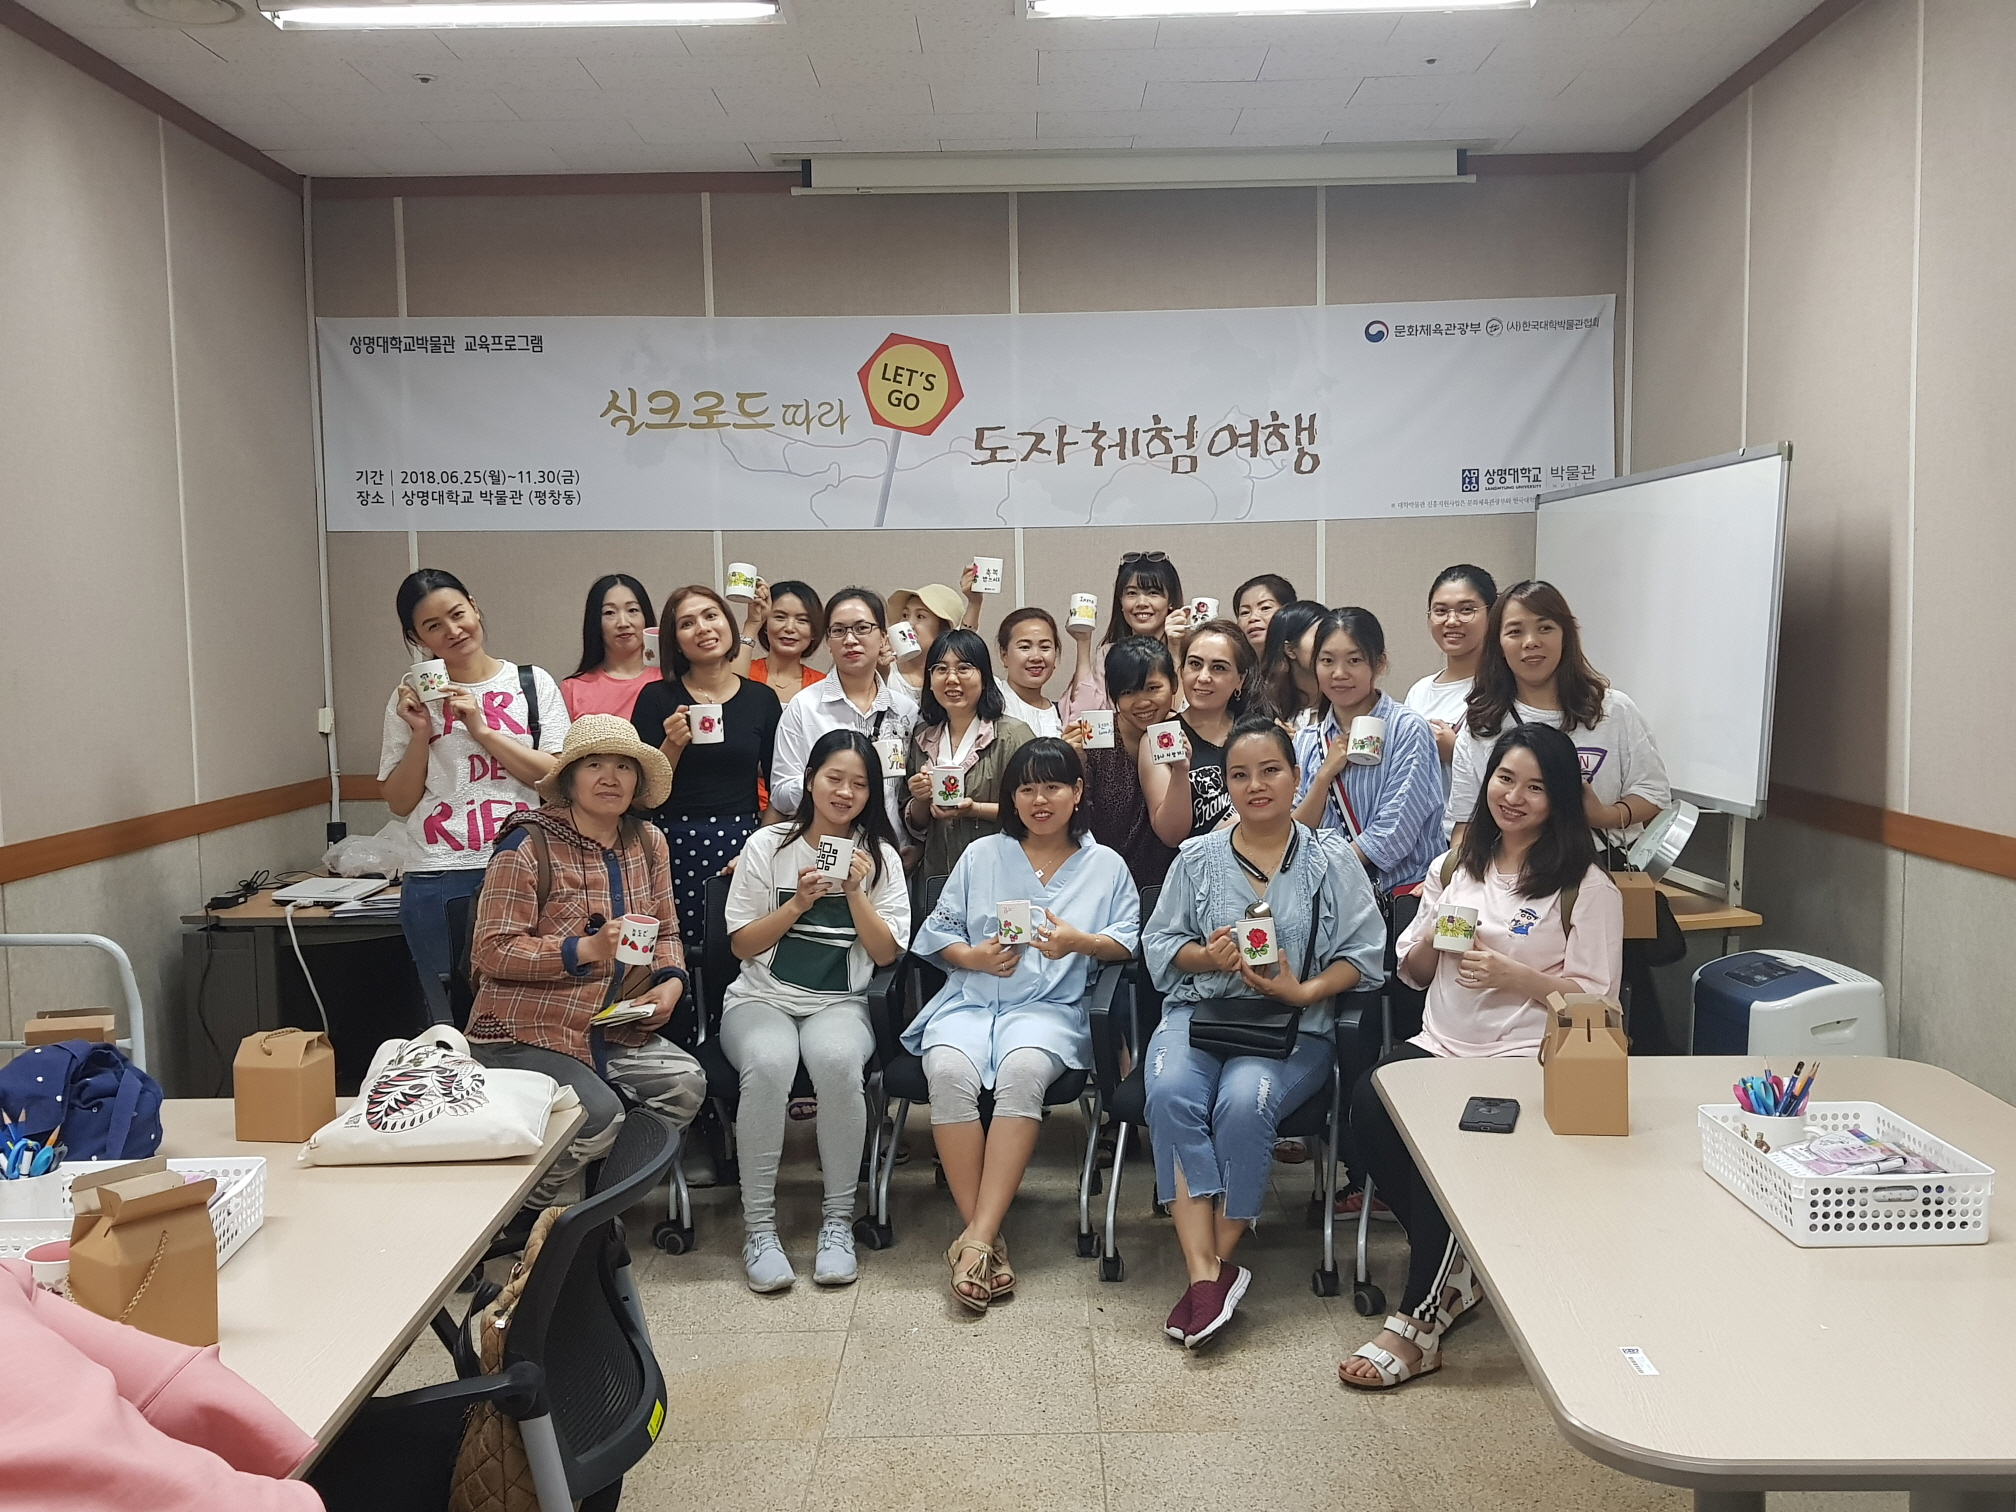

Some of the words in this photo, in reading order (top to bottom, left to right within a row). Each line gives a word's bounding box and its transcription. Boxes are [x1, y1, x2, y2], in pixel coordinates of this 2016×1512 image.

[1393, 322, 1482, 338] 문화체육관광부
[349, 335, 456, 355] 상명대학교박물관
[464, 334, 544, 354] 교육프로그램
[887, 389, 920, 411] GO
[600, 387, 776, 436] 실크로드
[781, 398, 852, 436] 따라
[355, 469, 385, 486] 기간
[400, 469, 581, 486] 2018.06.25(월)~11.30(금)
[1484, 466, 1542, 485] 상명대학교
[1550, 464, 1597, 482] 박물관
[356, 489, 386, 507] 장소
[401, 489, 475, 507] 상명대학교
[479, 489, 524, 507] 박물관
[528, 489, 582, 507] (평창동)
